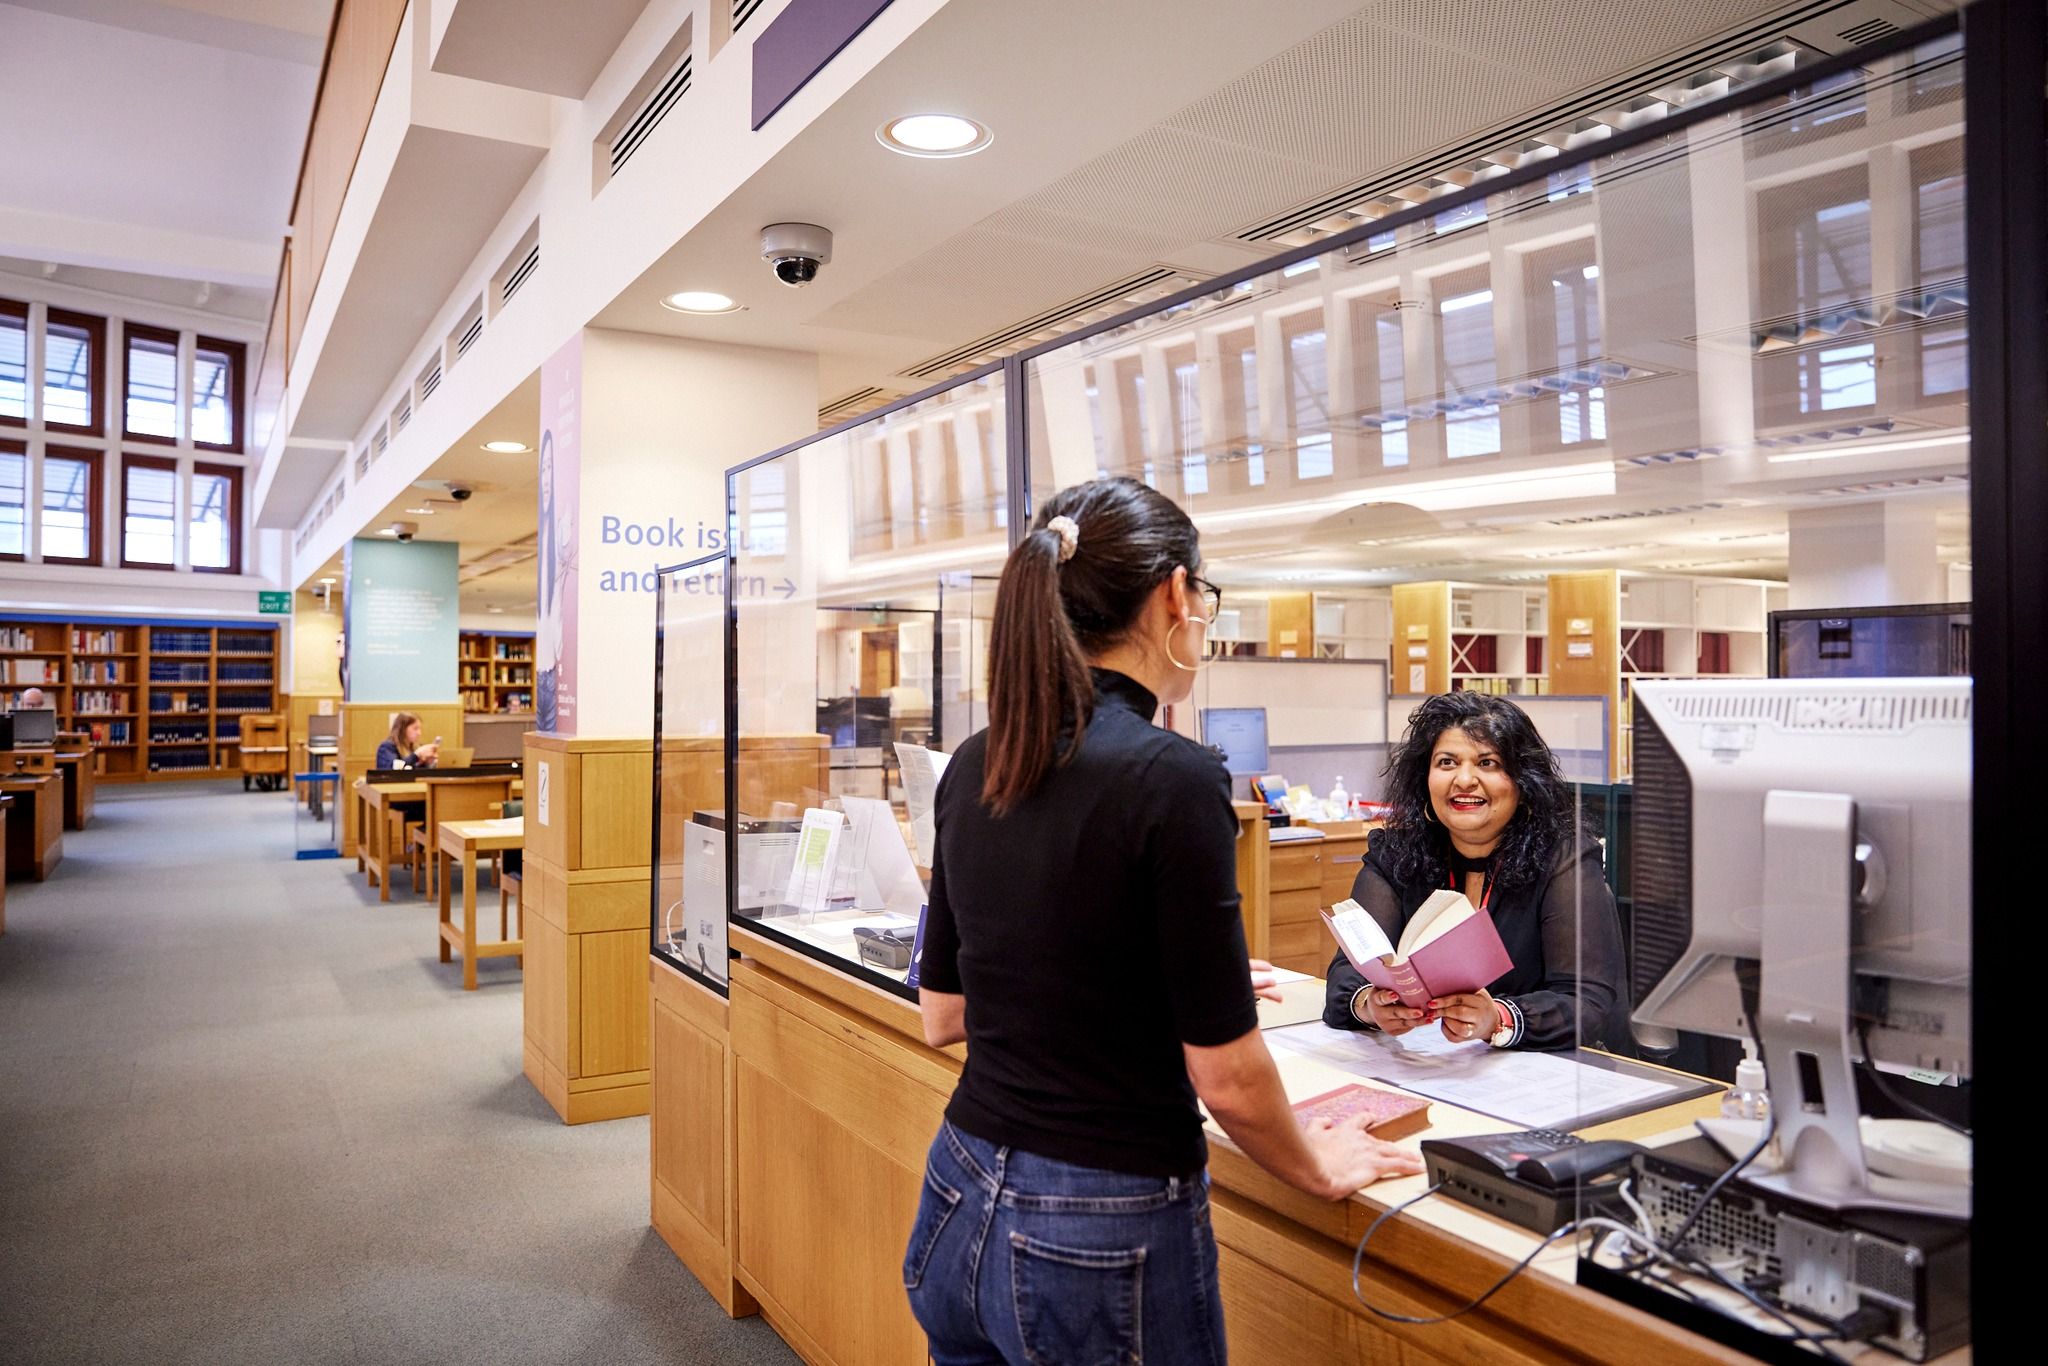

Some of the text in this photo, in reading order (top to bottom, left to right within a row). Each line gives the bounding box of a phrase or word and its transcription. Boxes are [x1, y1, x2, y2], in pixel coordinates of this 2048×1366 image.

[601, 515, 766, 551] Book isu
[599, 563, 660, 593] and
